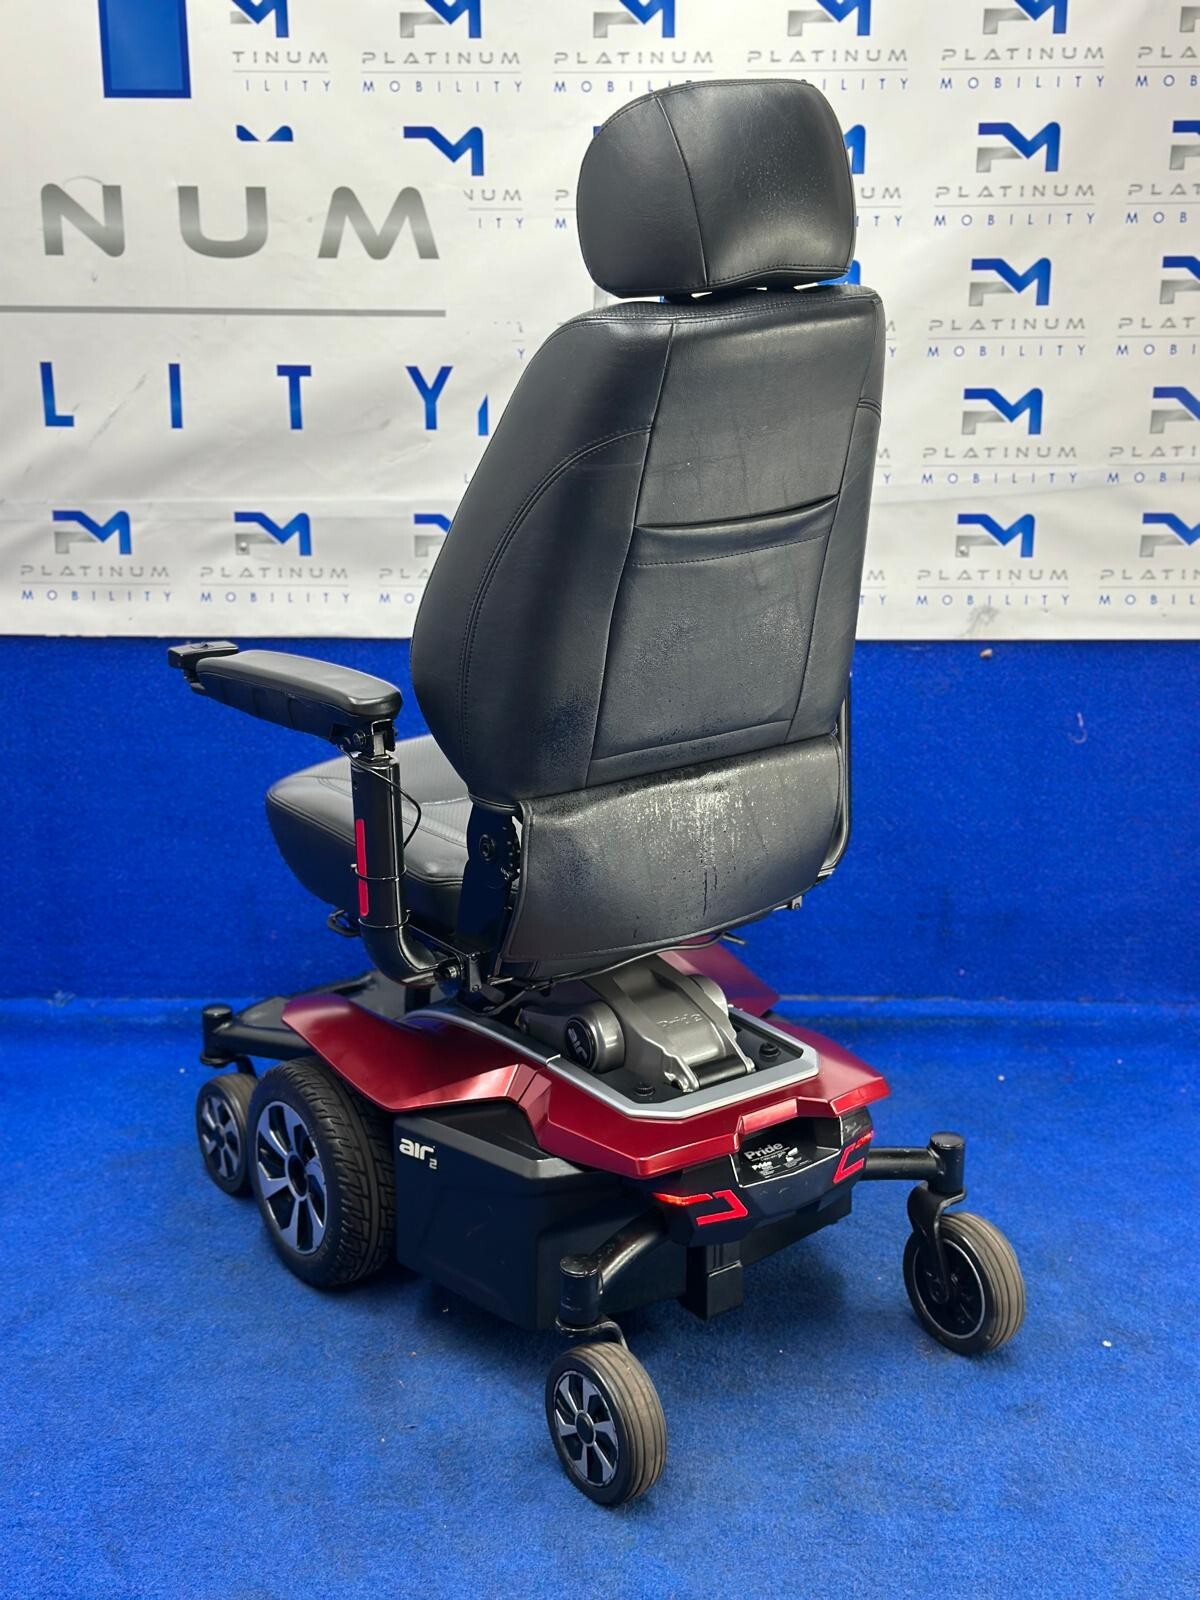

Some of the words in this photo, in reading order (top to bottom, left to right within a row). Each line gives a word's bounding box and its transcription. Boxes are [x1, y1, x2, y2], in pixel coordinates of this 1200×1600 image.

[232, 51, 328, 64] TINUM
[362, 51, 520, 64] PLATINUM
[554, 51, 713, 64] PLATINUM
[747, 49, 907, 63] PLATINUM
[941, 46, 1104, 61] PLATINUM
[363, 80, 522, 93] MOBILITY
[940, 75, 1104, 88] MOBILITY
[935, 184, 1095, 199] PLATINUM
[41, 183, 440, 260] NUM
[933, 212, 1095, 226] MOBILITY
[928, 318, 1085, 331] PLATINUM
[927, 344, 1086, 358] MOBILITY
[39, 361, 454, 431] LITY
[922, 446, 1077, 459] PLATINUM
[921, 472, 1077, 484] MOBILITY
[20, 565, 169, 578] PLATINUM
[200, 566, 348, 579] PLATINUM
[917, 568, 1068, 581] PLATINUM
[21, 590, 171, 602] MOBILITY
[200, 592, 349, 603] MOBILITY
[916, 594, 1069, 605] MOBILITY
[399, 1137, 434, 1161] air
[428, 1157, 438, 1170] 2
[744, 1142, 784, 1160] Pride
